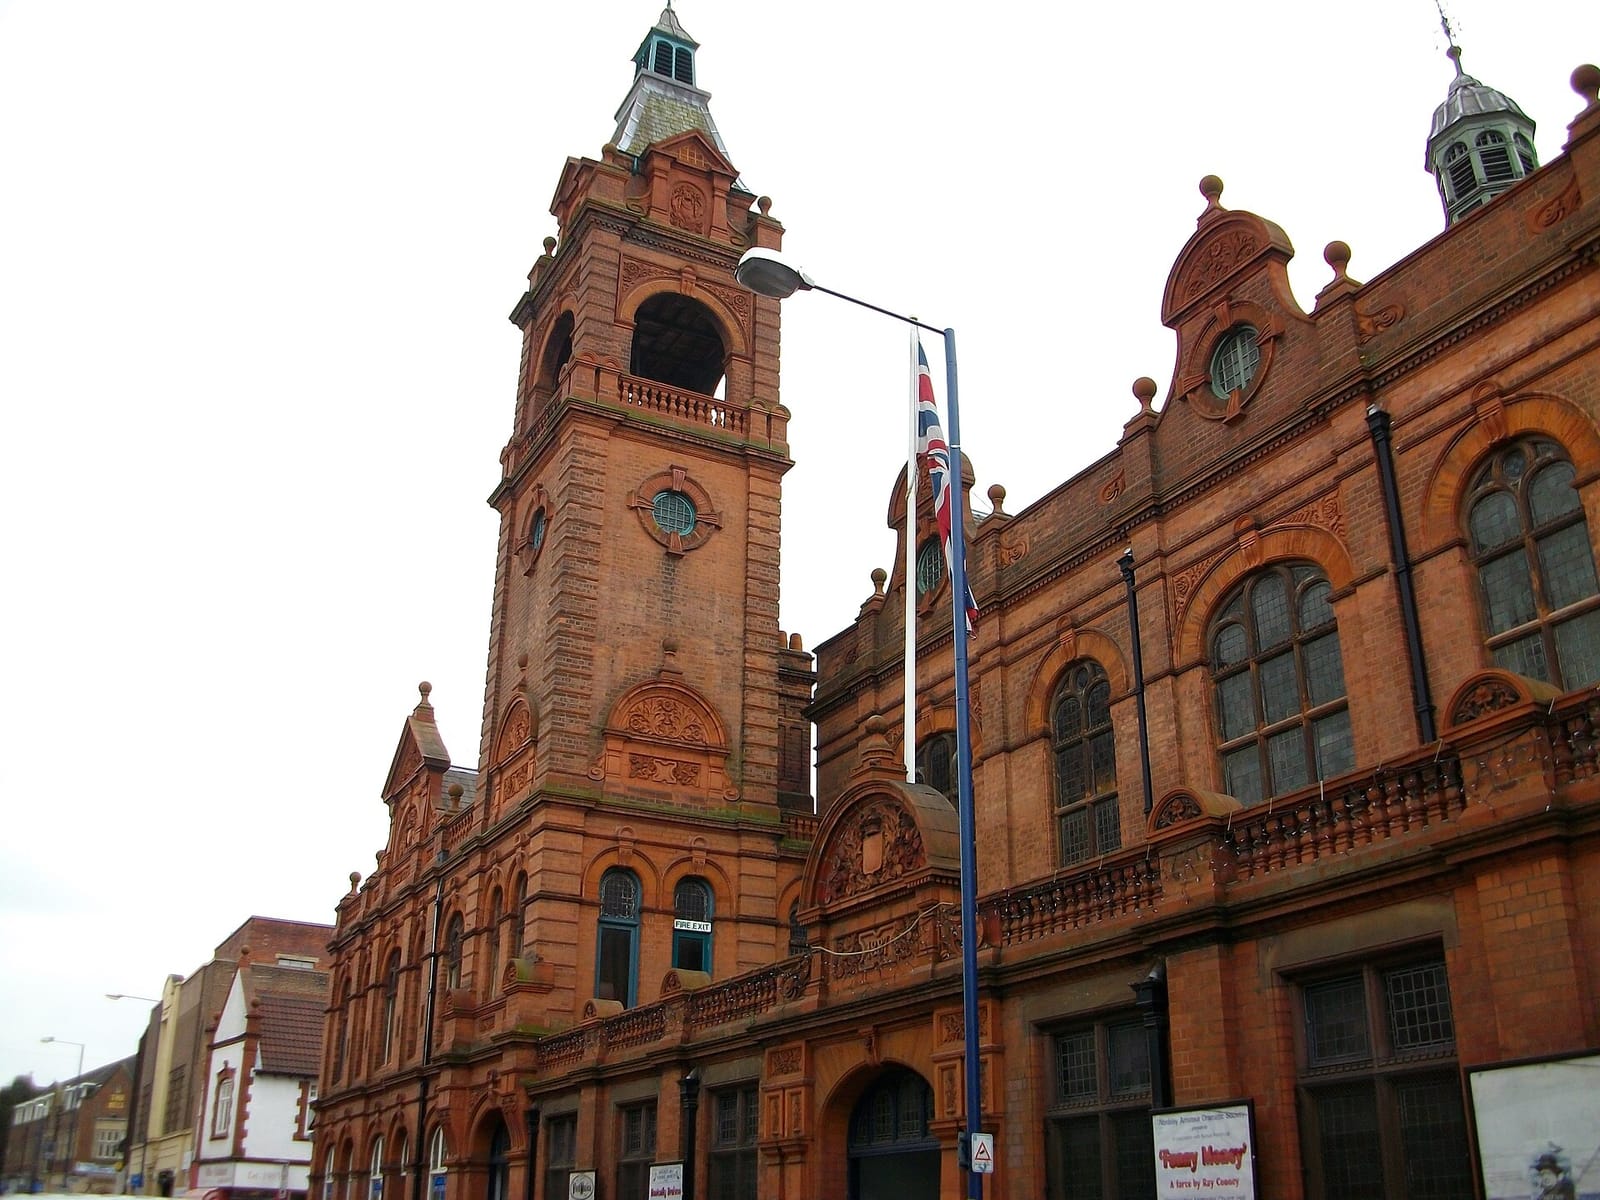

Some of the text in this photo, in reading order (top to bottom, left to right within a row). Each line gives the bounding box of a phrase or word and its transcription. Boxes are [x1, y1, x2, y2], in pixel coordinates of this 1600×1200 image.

[693, 922, 709, 930] EXIT
[1170, 1180, 1174, 1188] A
[1176, 1180, 1191, 1188] farce
[1193, 1178, 1200, 1189] by
[1203, 1178, 1214, 1189] Ray
